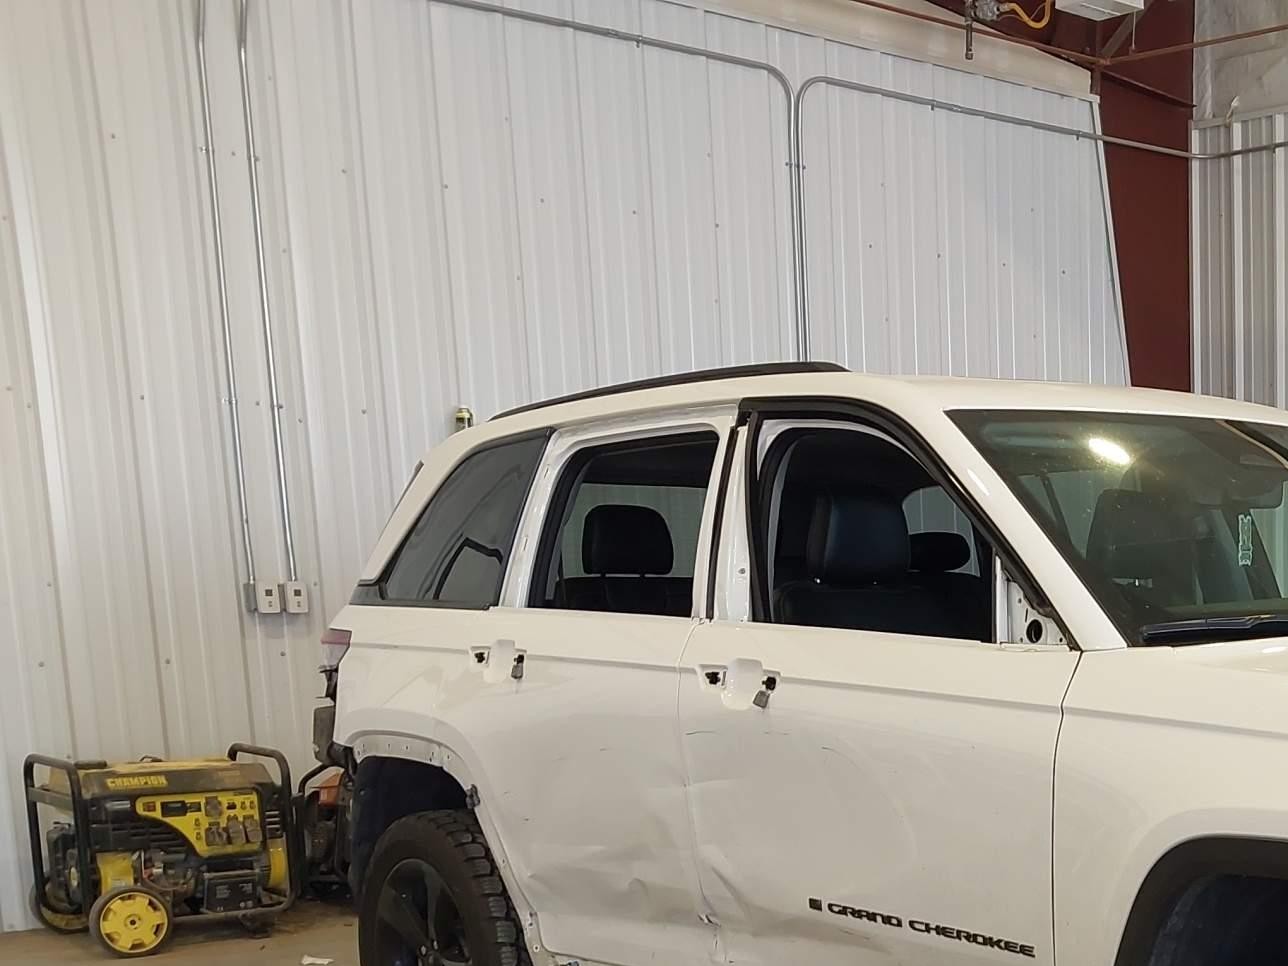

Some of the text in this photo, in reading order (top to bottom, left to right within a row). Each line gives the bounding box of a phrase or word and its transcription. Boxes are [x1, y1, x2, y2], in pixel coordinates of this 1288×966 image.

[106, 775, 167, 788] CHAMPION
[827, 903, 1035, 958] GRAND CHEROKEE
